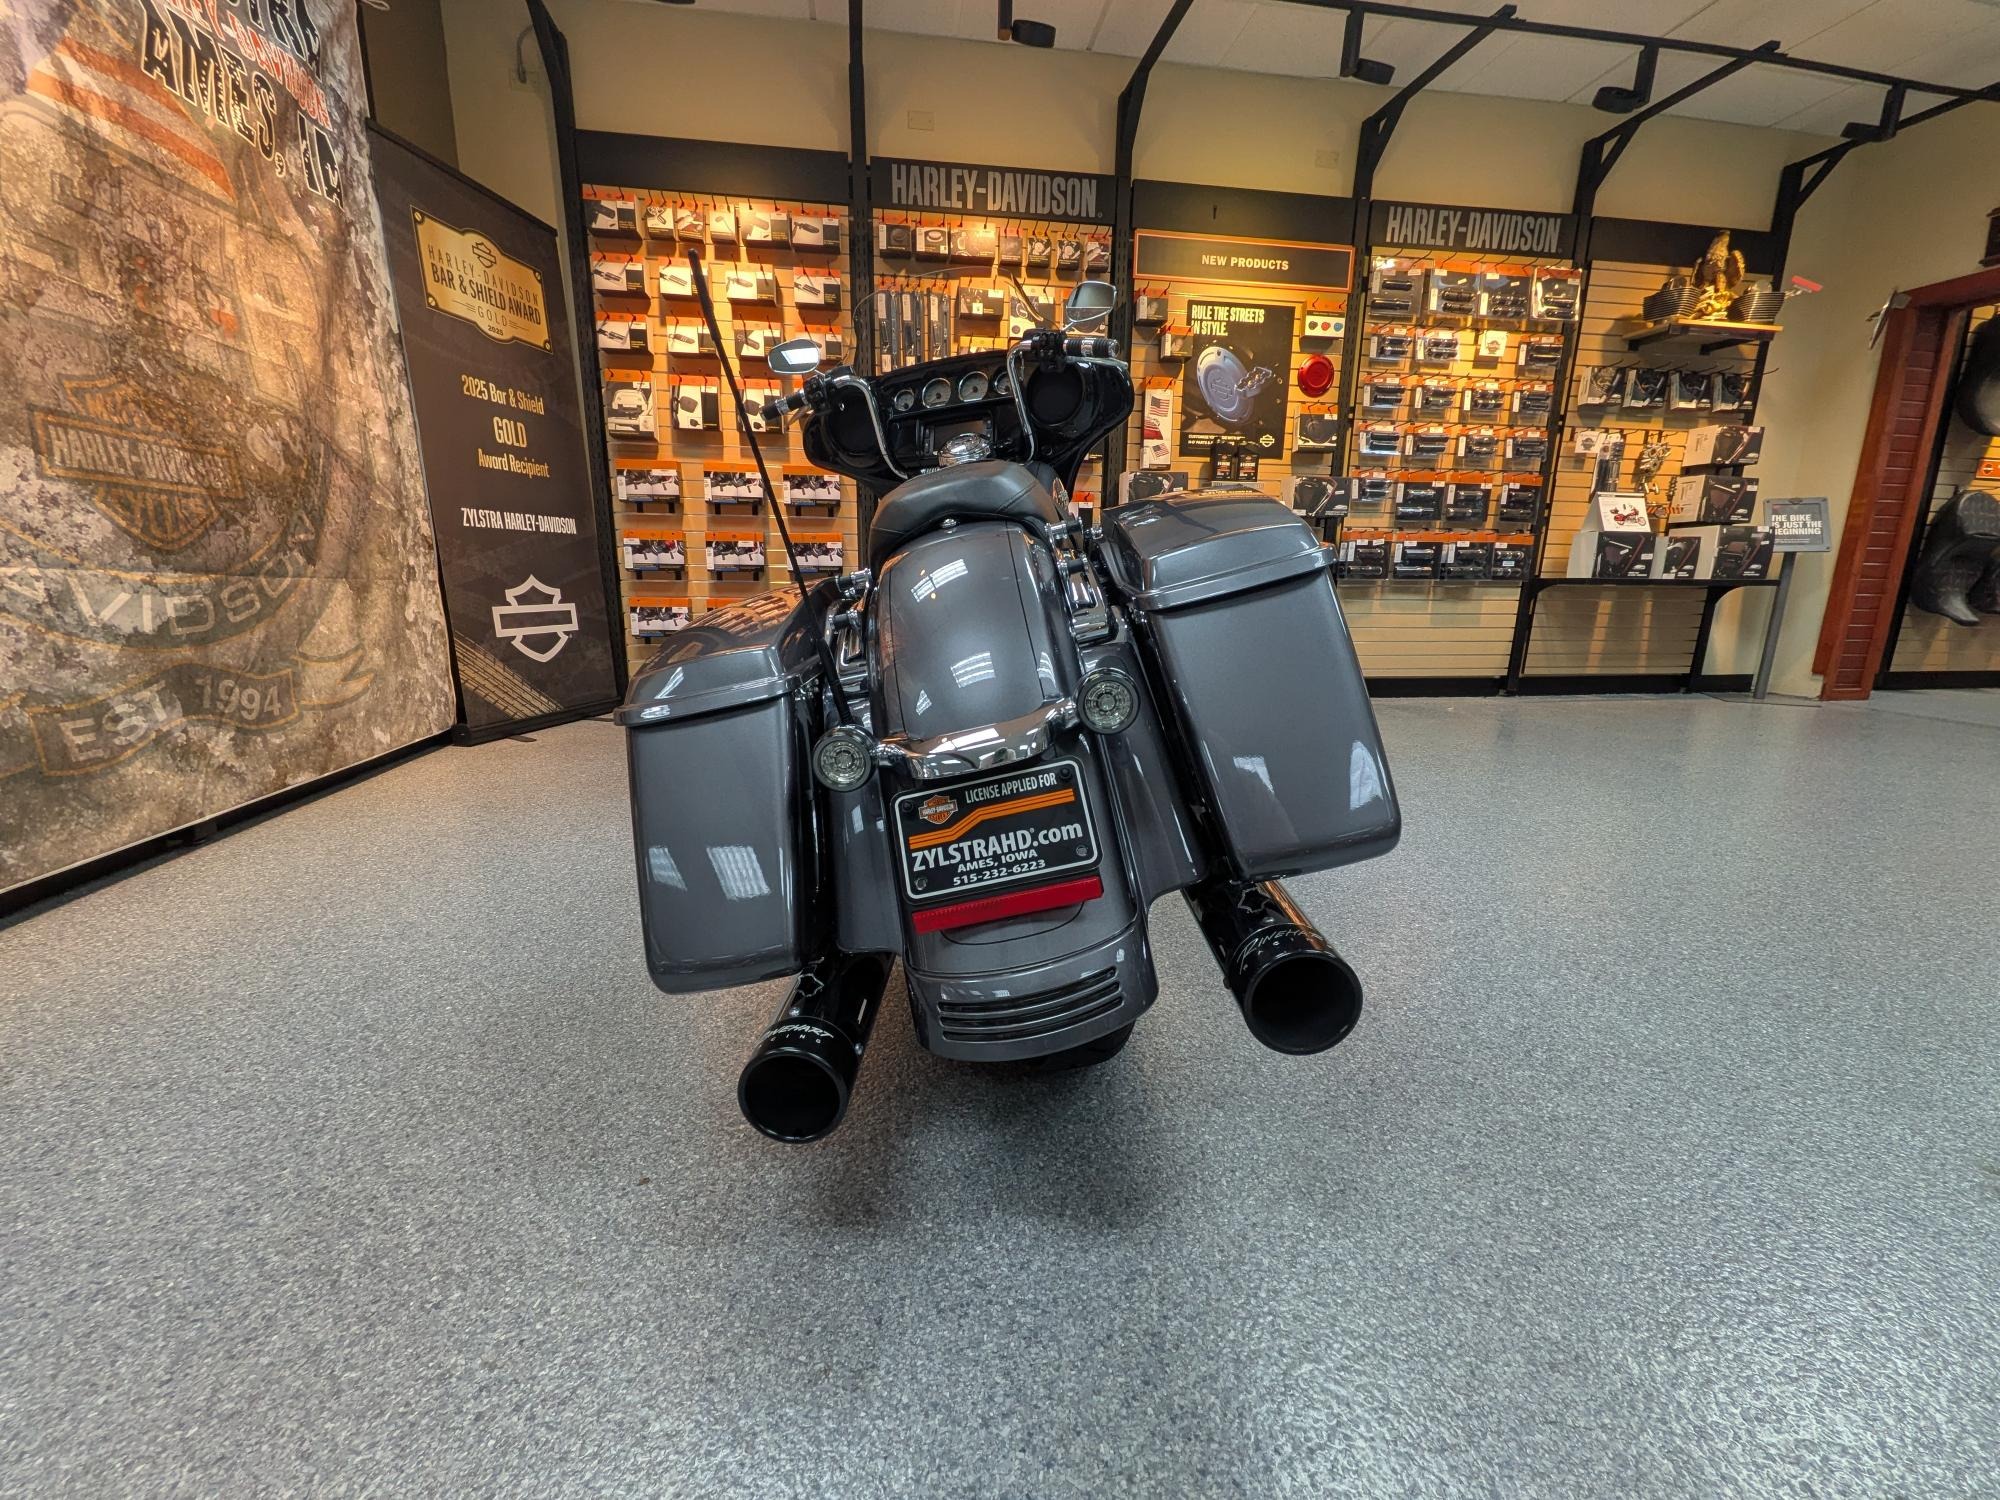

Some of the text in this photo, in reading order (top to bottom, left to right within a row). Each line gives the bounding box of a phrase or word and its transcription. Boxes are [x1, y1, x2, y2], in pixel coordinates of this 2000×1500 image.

[891, 163, 1097, 218] HARLEY-DAVIDSON
[1385, 206, 1562, 254] HARLEY-DAVIDSON
[428, 244, 539, 306] HARLEY-DAVIDSON
[1201, 254, 1289, 271] NEW PRODUCTS
[431, 263, 541, 326] BAR & SHIELD AWARD
[478, 306, 508, 327] GOLD
[1191, 304, 1265, 324] RULE THE STREETS
[1201, 321, 1229, 336] STYLE.
[461, 374, 545, 415] 2025 Bar & Shield
[493, 416, 528, 448] GOLD
[478, 448, 550, 479] Award Recipient
[461, 507, 577, 535] ZYLSTRA HARLEY-DAVIDSON
[1771, 514, 1812, 522] THE BIKE
[1782, 521, 1804, 529] JUST
[1805, 520, 1824, 528] THE
[196, 674, 283, 721] 1994
[59, 680, 170, 763] EST
[965, 785, 1000, 804] LICENSE
[1001, 776, 1038, 797] APPLIED
[1038, 772, 1058, 788] FOR
[911, 823, 1083, 872] ZYLSTRAHD.com
[957, 849, 1038, 874] AMES, IOWA
[953, 859, 1046, 886] 515-232-6223
[762, 1024, 835, 1039] INEHART
